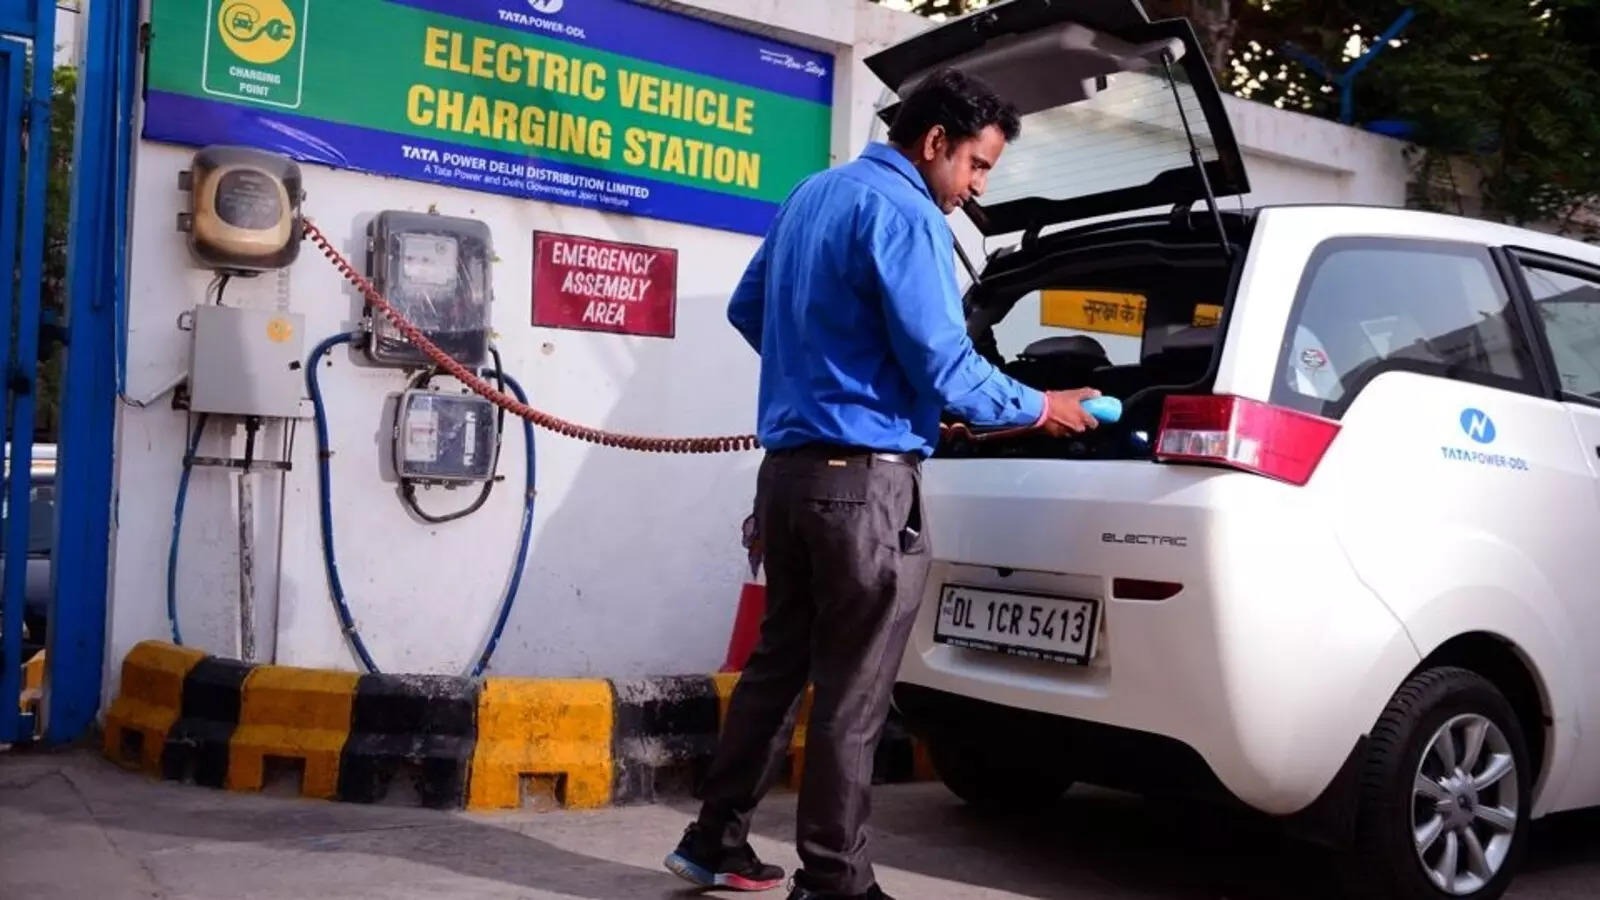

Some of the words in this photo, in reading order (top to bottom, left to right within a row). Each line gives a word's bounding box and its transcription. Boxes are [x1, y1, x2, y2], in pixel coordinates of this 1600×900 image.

[229, 65, 281, 84] CHARGING
[240, 82, 269, 97] POINT
[424, 26, 607, 101] ELECTRIC
[618, 69, 755, 135] VEHICLE
[406, 84, 613, 160] CHARGING
[622, 127, 761, 189] STATION
[401, 145, 440, 163] TATA
[442, 152, 487, 171] POWER
[489, 160, 524, 178] DELHI
[526, 166, 605, 191] DISTRIBUTION
[606, 181, 650, 200] LIMITED
[423, 164, 432, 174] A
[454, 168, 482, 182] Power
[551, 241, 657, 275] EMERGENCY
[561, 270, 653, 302] ASSEMBLY
[582, 301, 627, 326] AREA
[1102, 532, 1188, 547] ELECTRIC
[952, 597, 975, 630] DL
[987, 601, 1023, 636] 1CR
[1028, 604, 1087, 643] 5413
